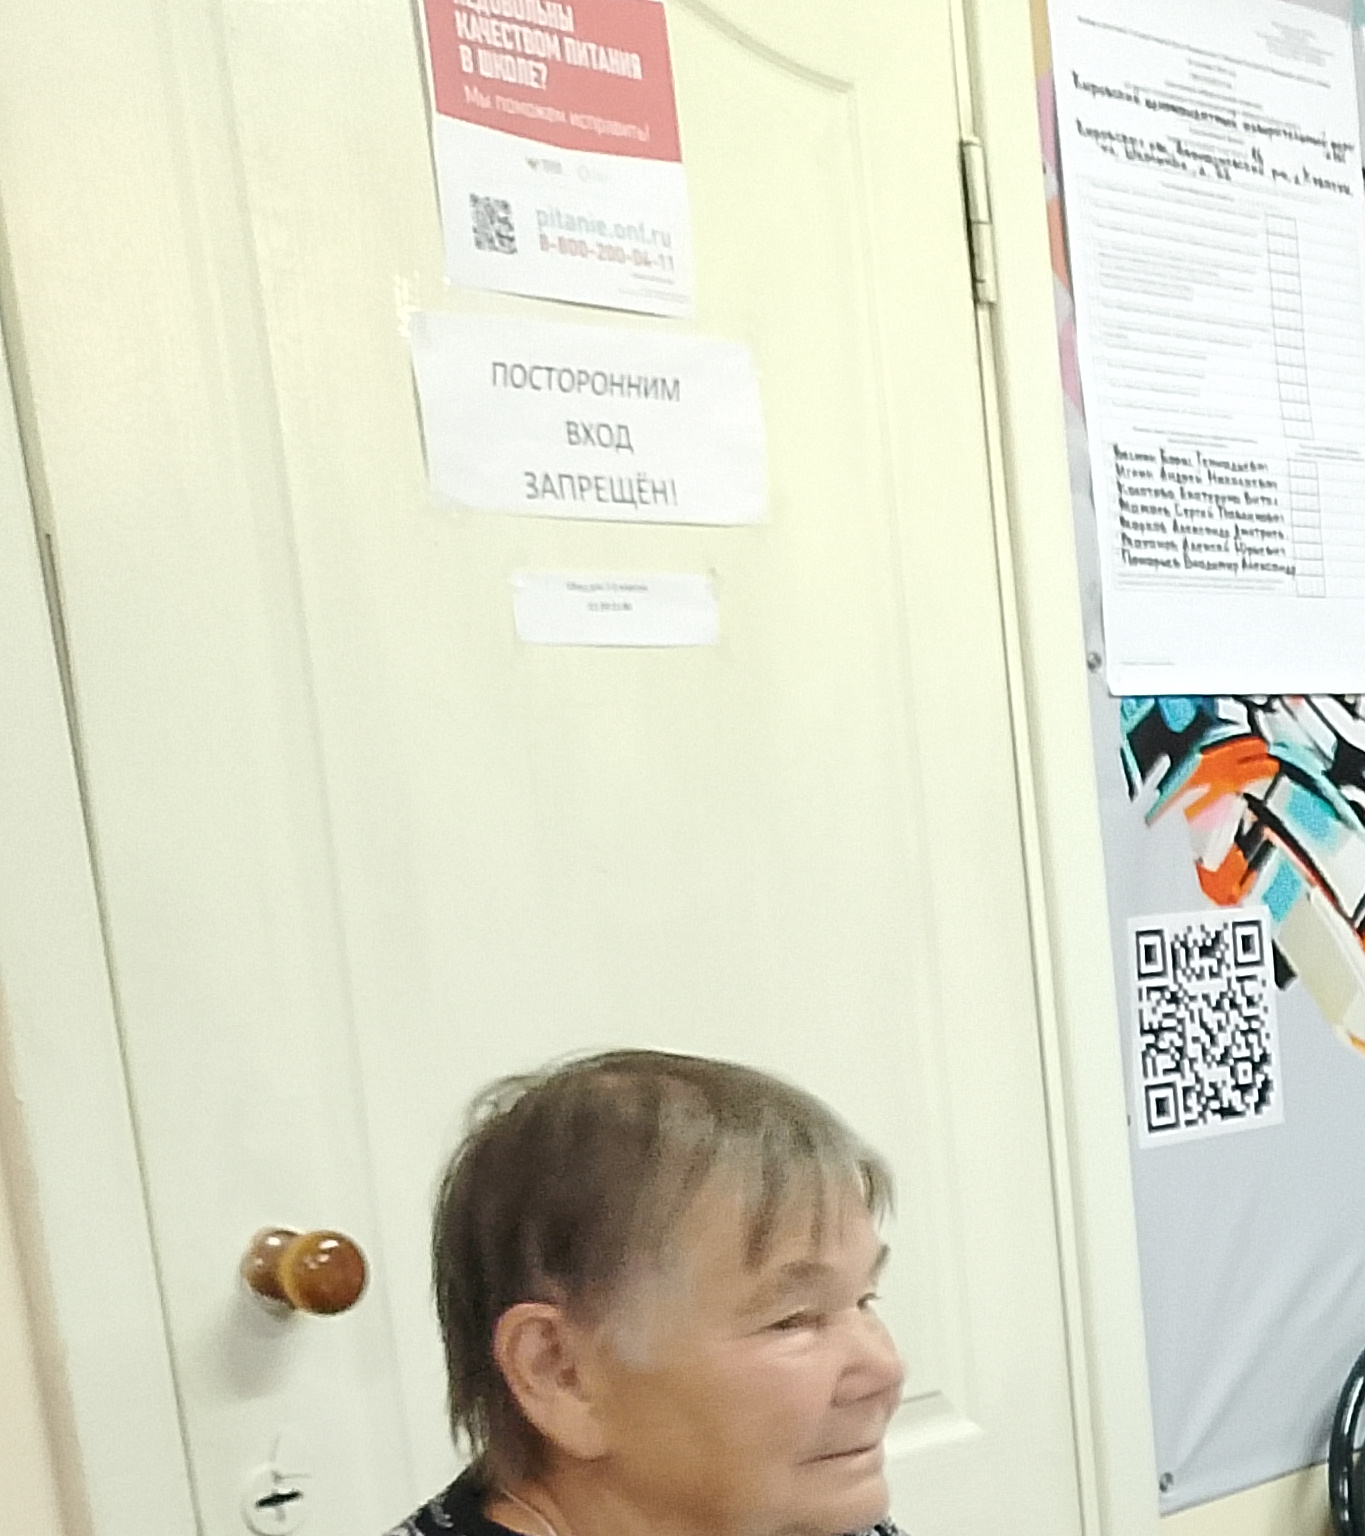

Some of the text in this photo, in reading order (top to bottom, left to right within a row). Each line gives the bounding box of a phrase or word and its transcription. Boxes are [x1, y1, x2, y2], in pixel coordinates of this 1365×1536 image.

[455, 10, 642, 80] КАЧЕСТВОМ ПИТАНИЯ
[459, 45, 547, 90] В ШКОЛЕ?
[491, 361, 681, 402] ПОСТОРОННИМ
[566, 420, 635, 454] ВХОД
[523, 471, 678, 509] ЗАПРЕЩЁН!
